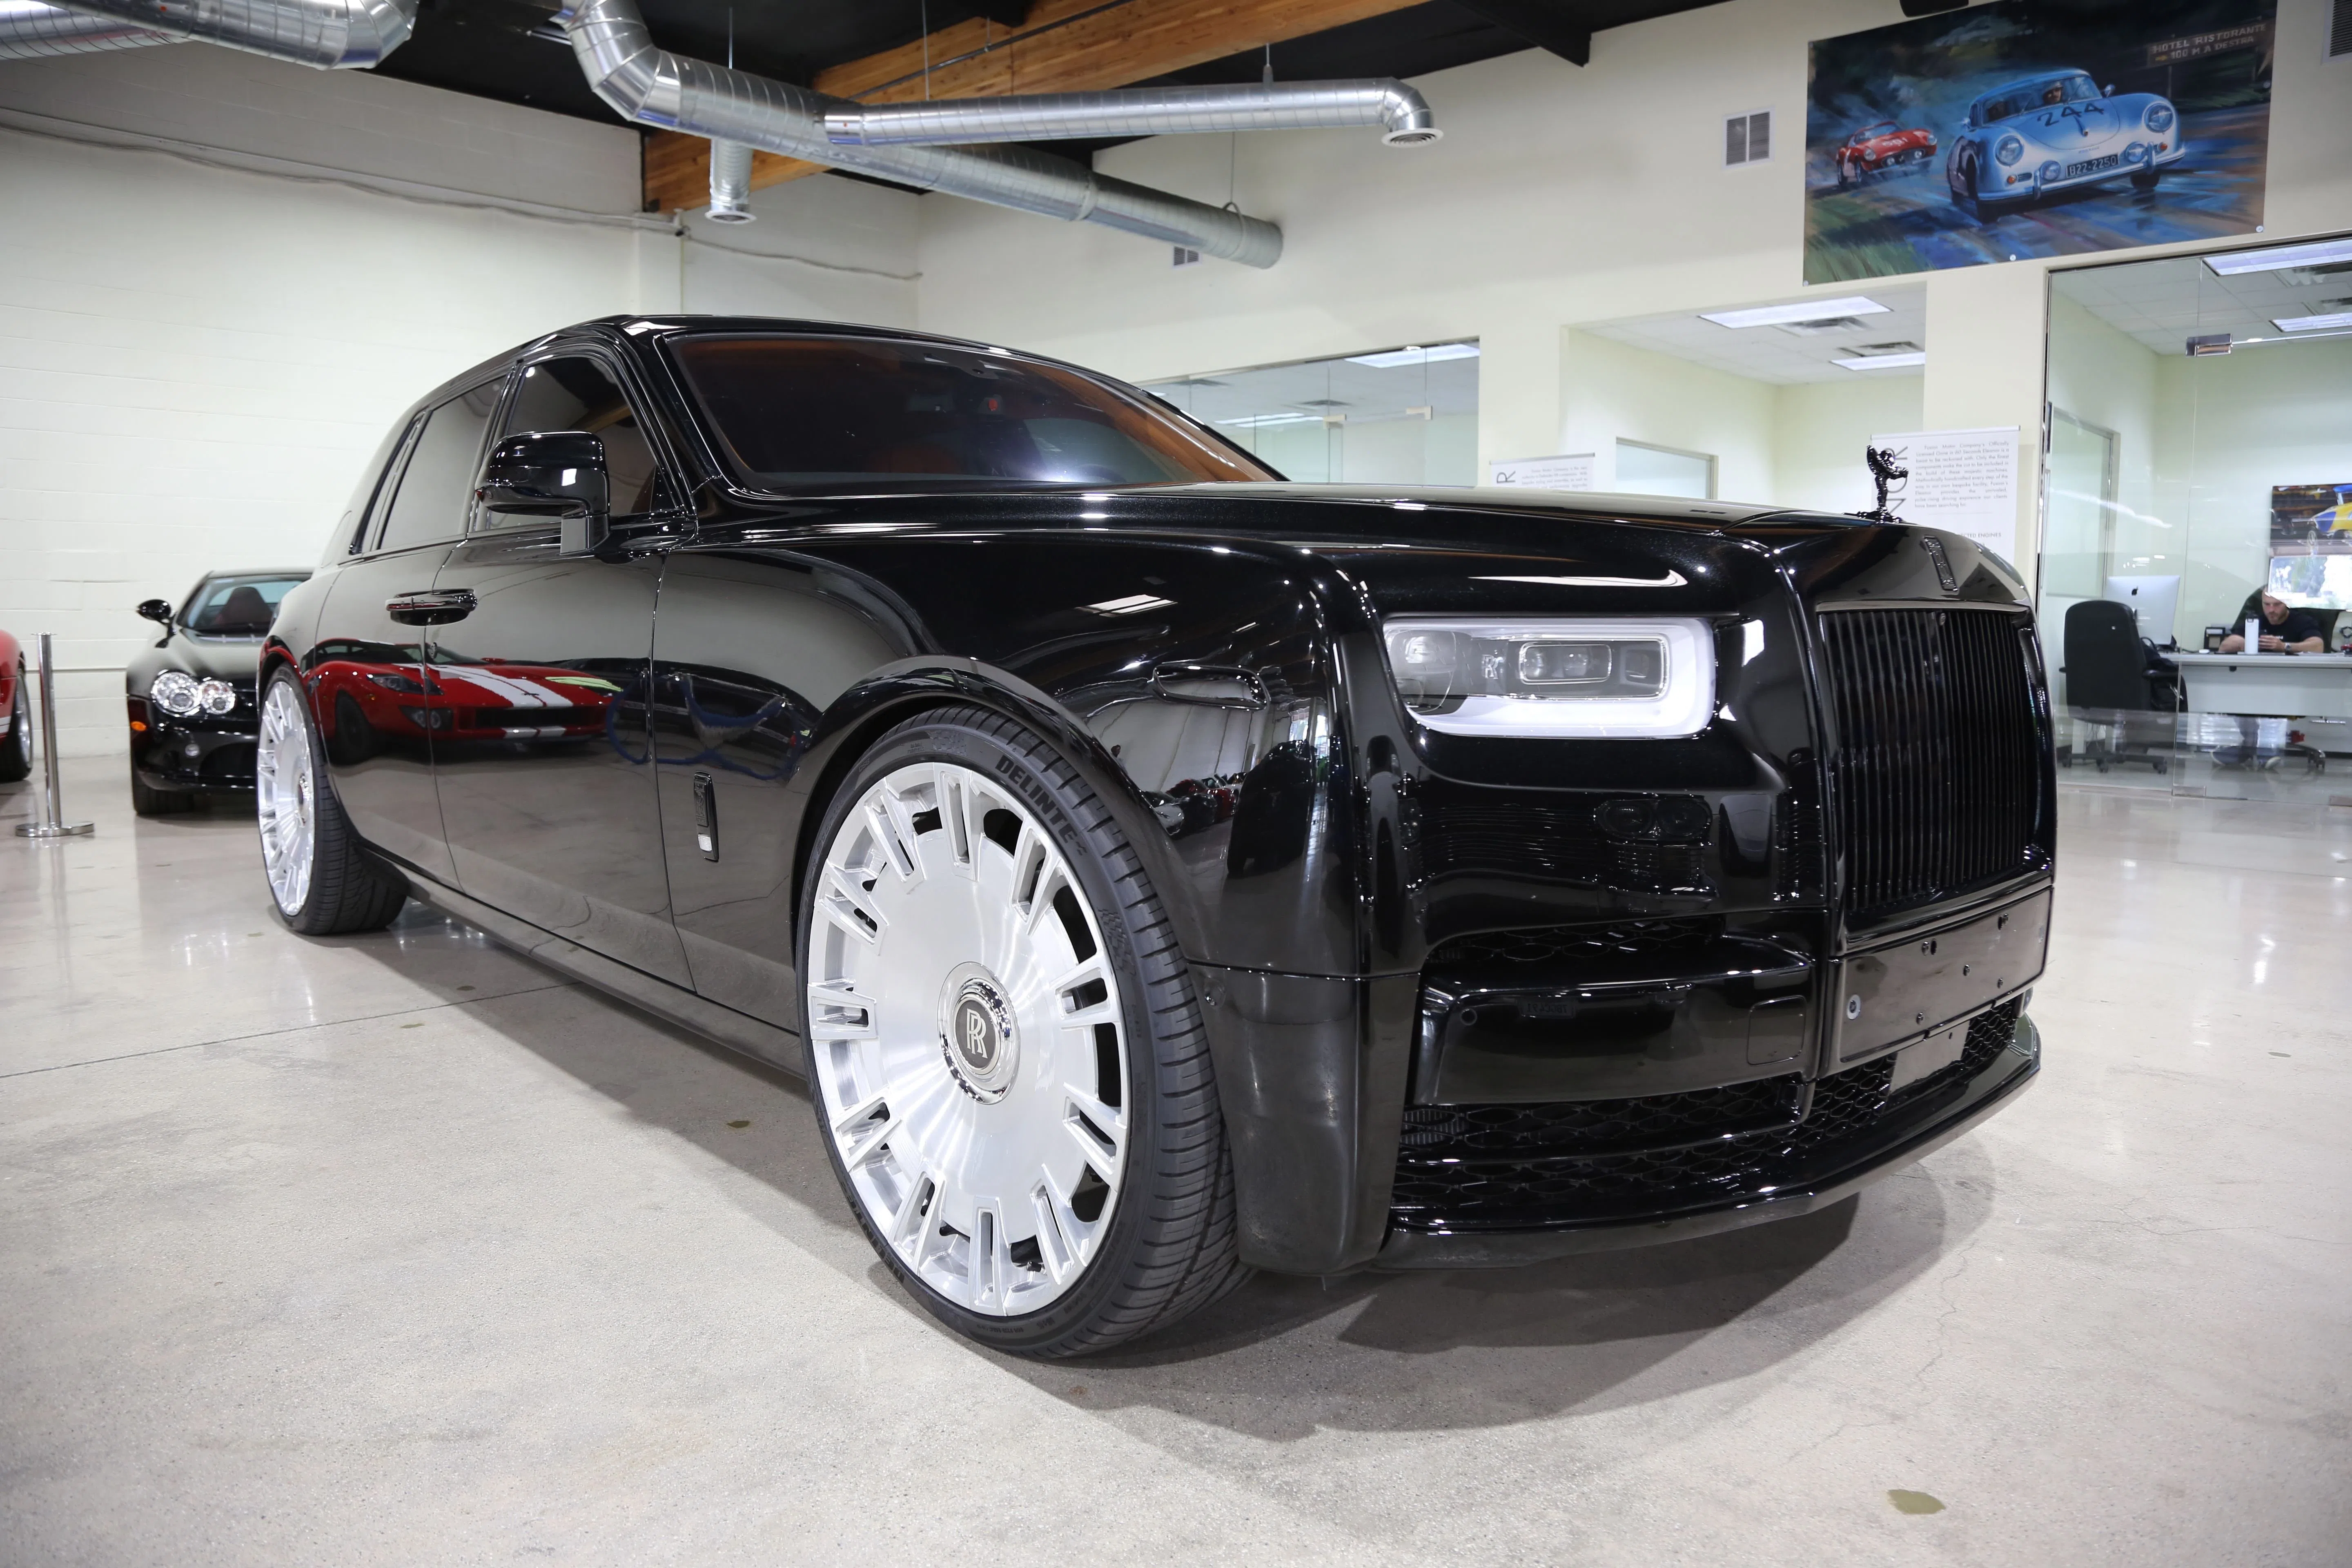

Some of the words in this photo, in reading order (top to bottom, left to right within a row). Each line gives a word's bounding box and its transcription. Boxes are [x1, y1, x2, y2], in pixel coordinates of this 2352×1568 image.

[2152, 40, 2190, 53] HOTEL
[2195, 23, 2266, 45] RISTORANTE
[2170, 49, 2188, 59] 100
[2214, 36, 2254, 50] DESTRA
[2037, 102, 2104, 127] 244
[995, 754, 1077, 844] DELINTE
[967, 1008, 988, 1059] RR
[846, 1194, 905, 1284] DELINTE
